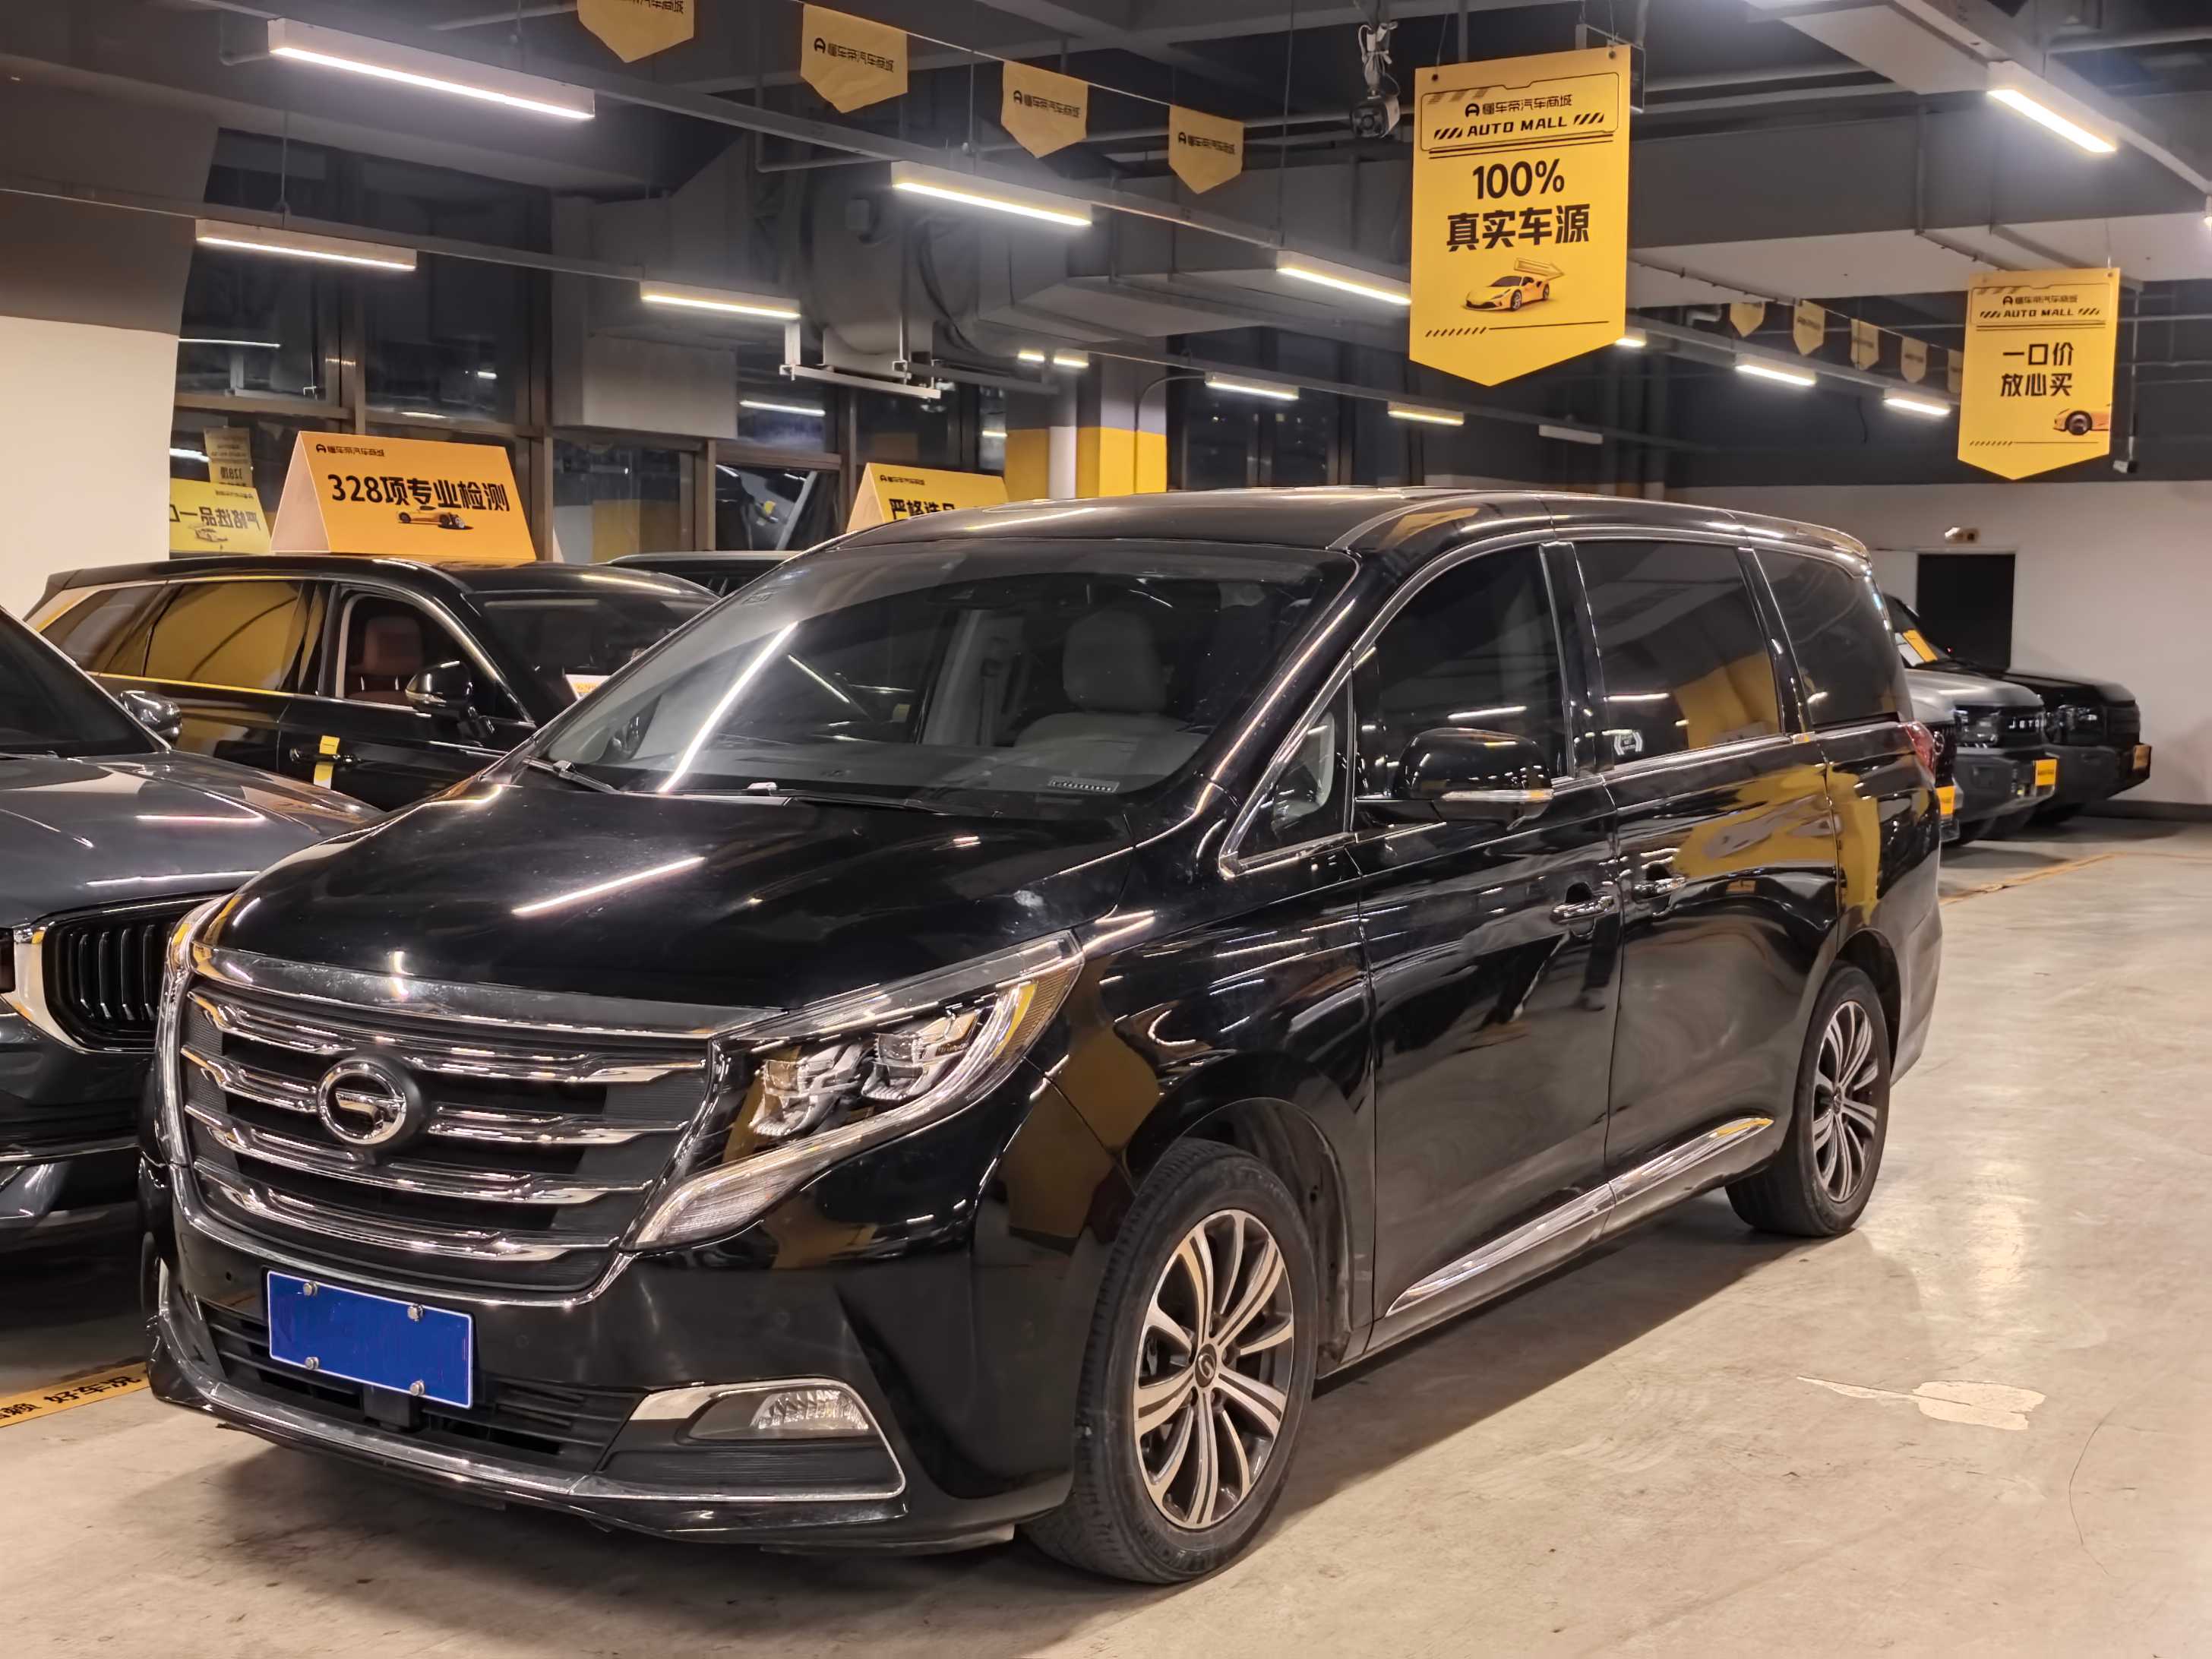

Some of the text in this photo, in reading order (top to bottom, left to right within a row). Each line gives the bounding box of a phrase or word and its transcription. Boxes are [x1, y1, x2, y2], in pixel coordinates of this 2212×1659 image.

[1482, 94, 1573, 115] 懂车帝汽车商城
[1467, 115, 1568, 137] AUTO MALL
[1472, 158, 1565, 200] 100%
[1446, 203, 1591, 252] 真实车源
[2003, 308, 2075, 318] AUTO MALL
[2002, 342, 2074, 366] 一口价
[1999, 373, 2073, 397] 放心买
[327, 474, 510, 512] 328项专业检测
